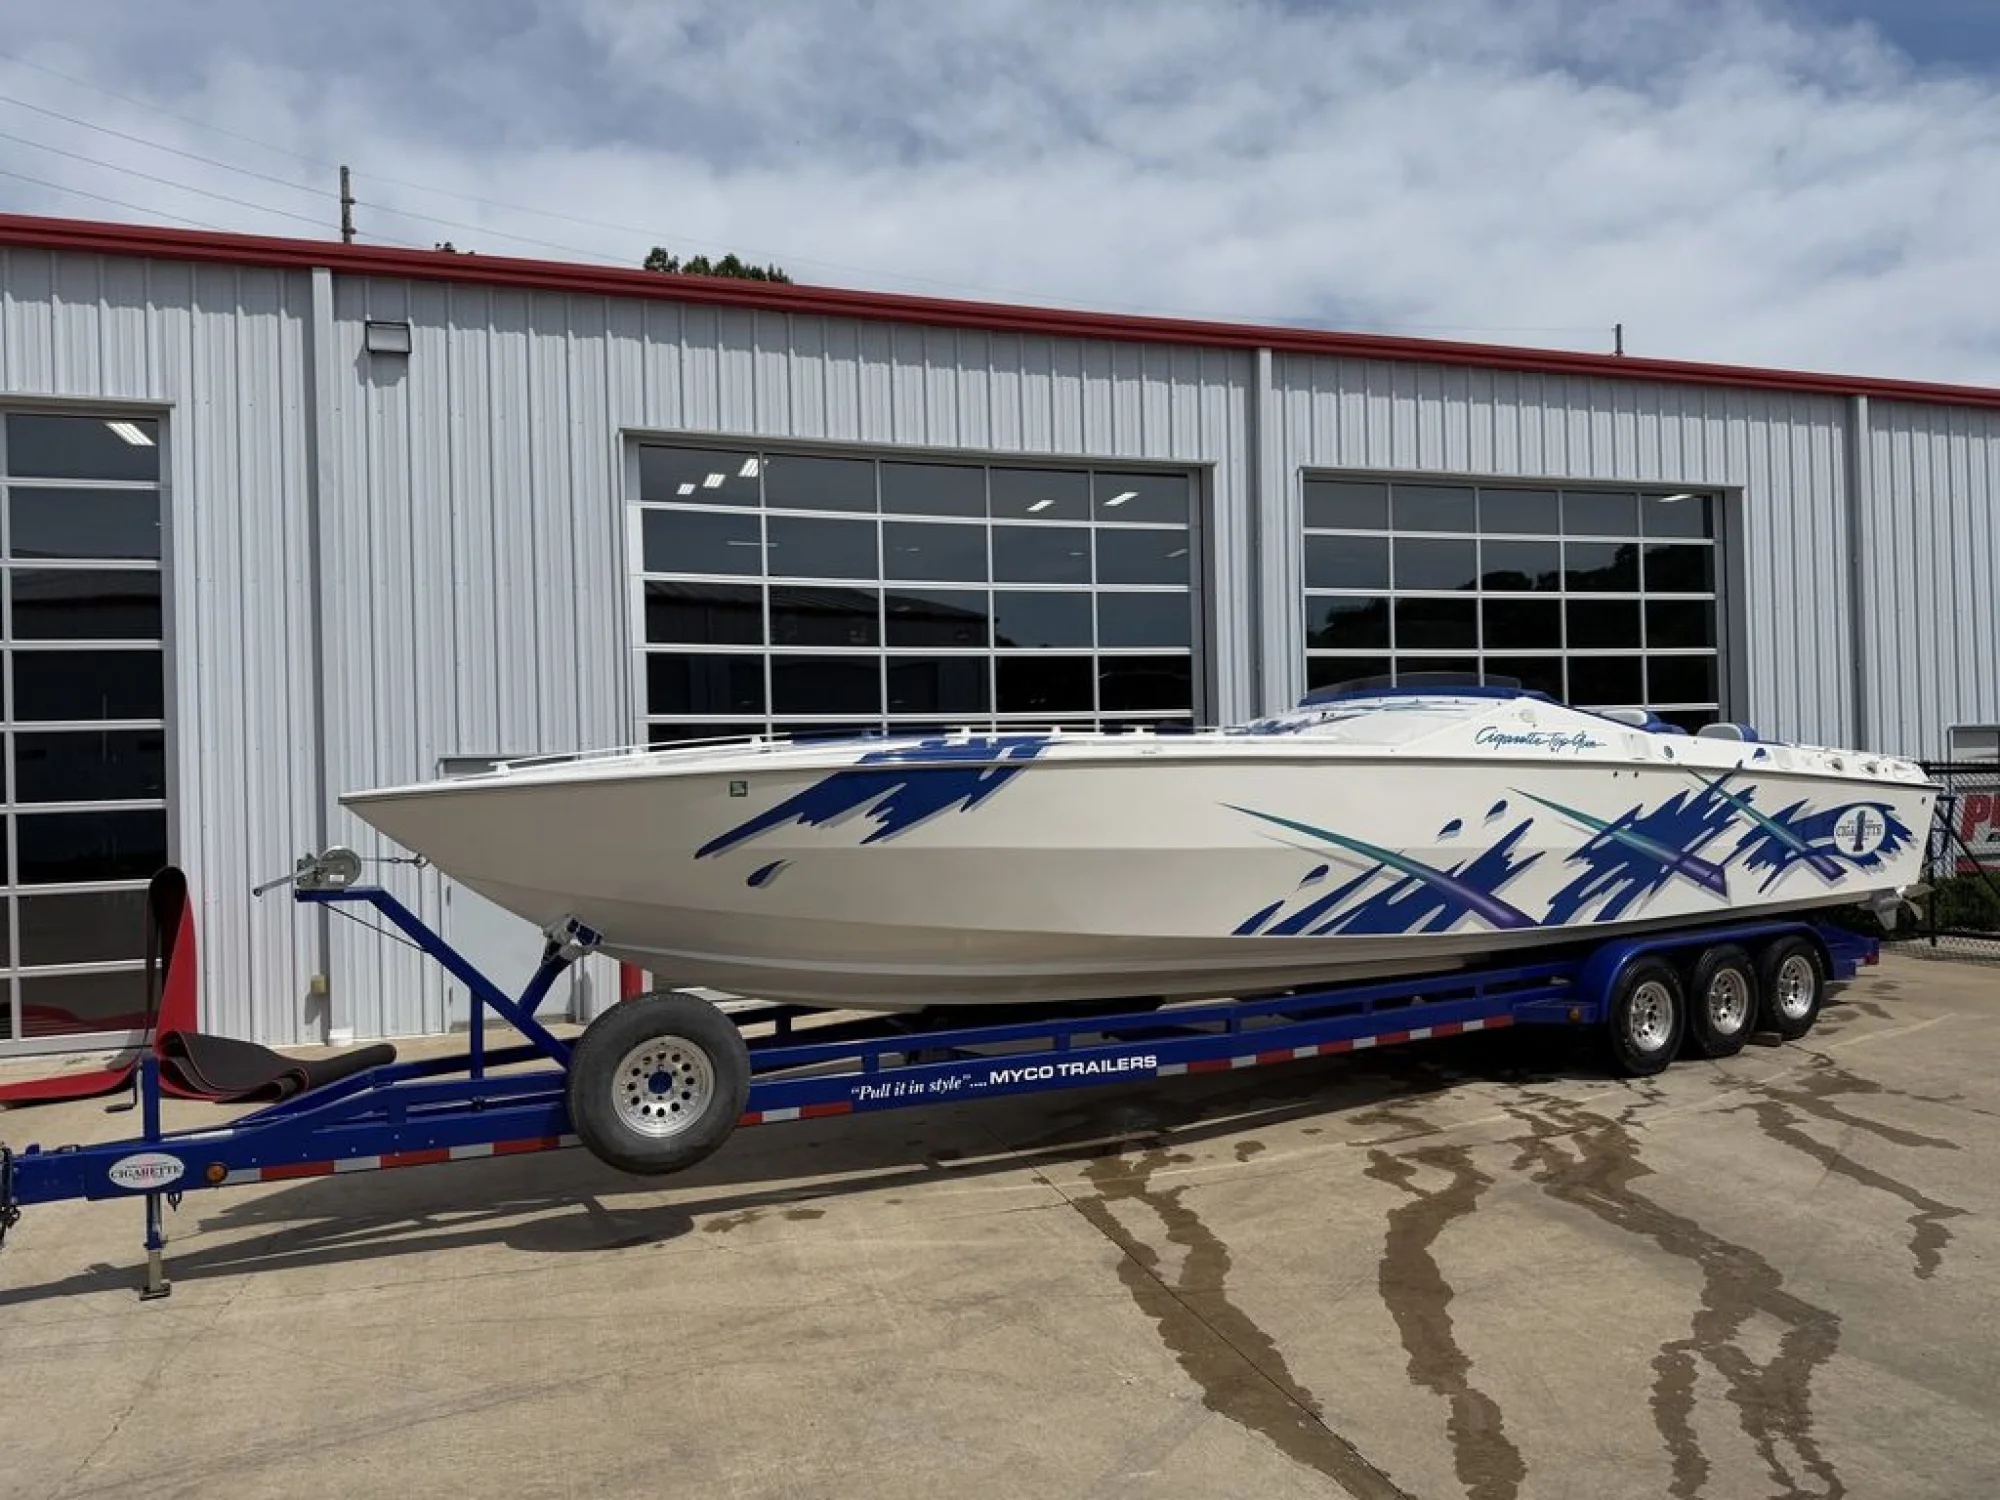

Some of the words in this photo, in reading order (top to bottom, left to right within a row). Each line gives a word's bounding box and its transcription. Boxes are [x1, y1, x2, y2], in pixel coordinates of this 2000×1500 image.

[894, 1081, 906, 1096] it
[908, 1079, 925, 1095] in
[989, 1065, 1053, 1085] MYCO
[1057, 1054, 1157, 1077] TRAILERS
